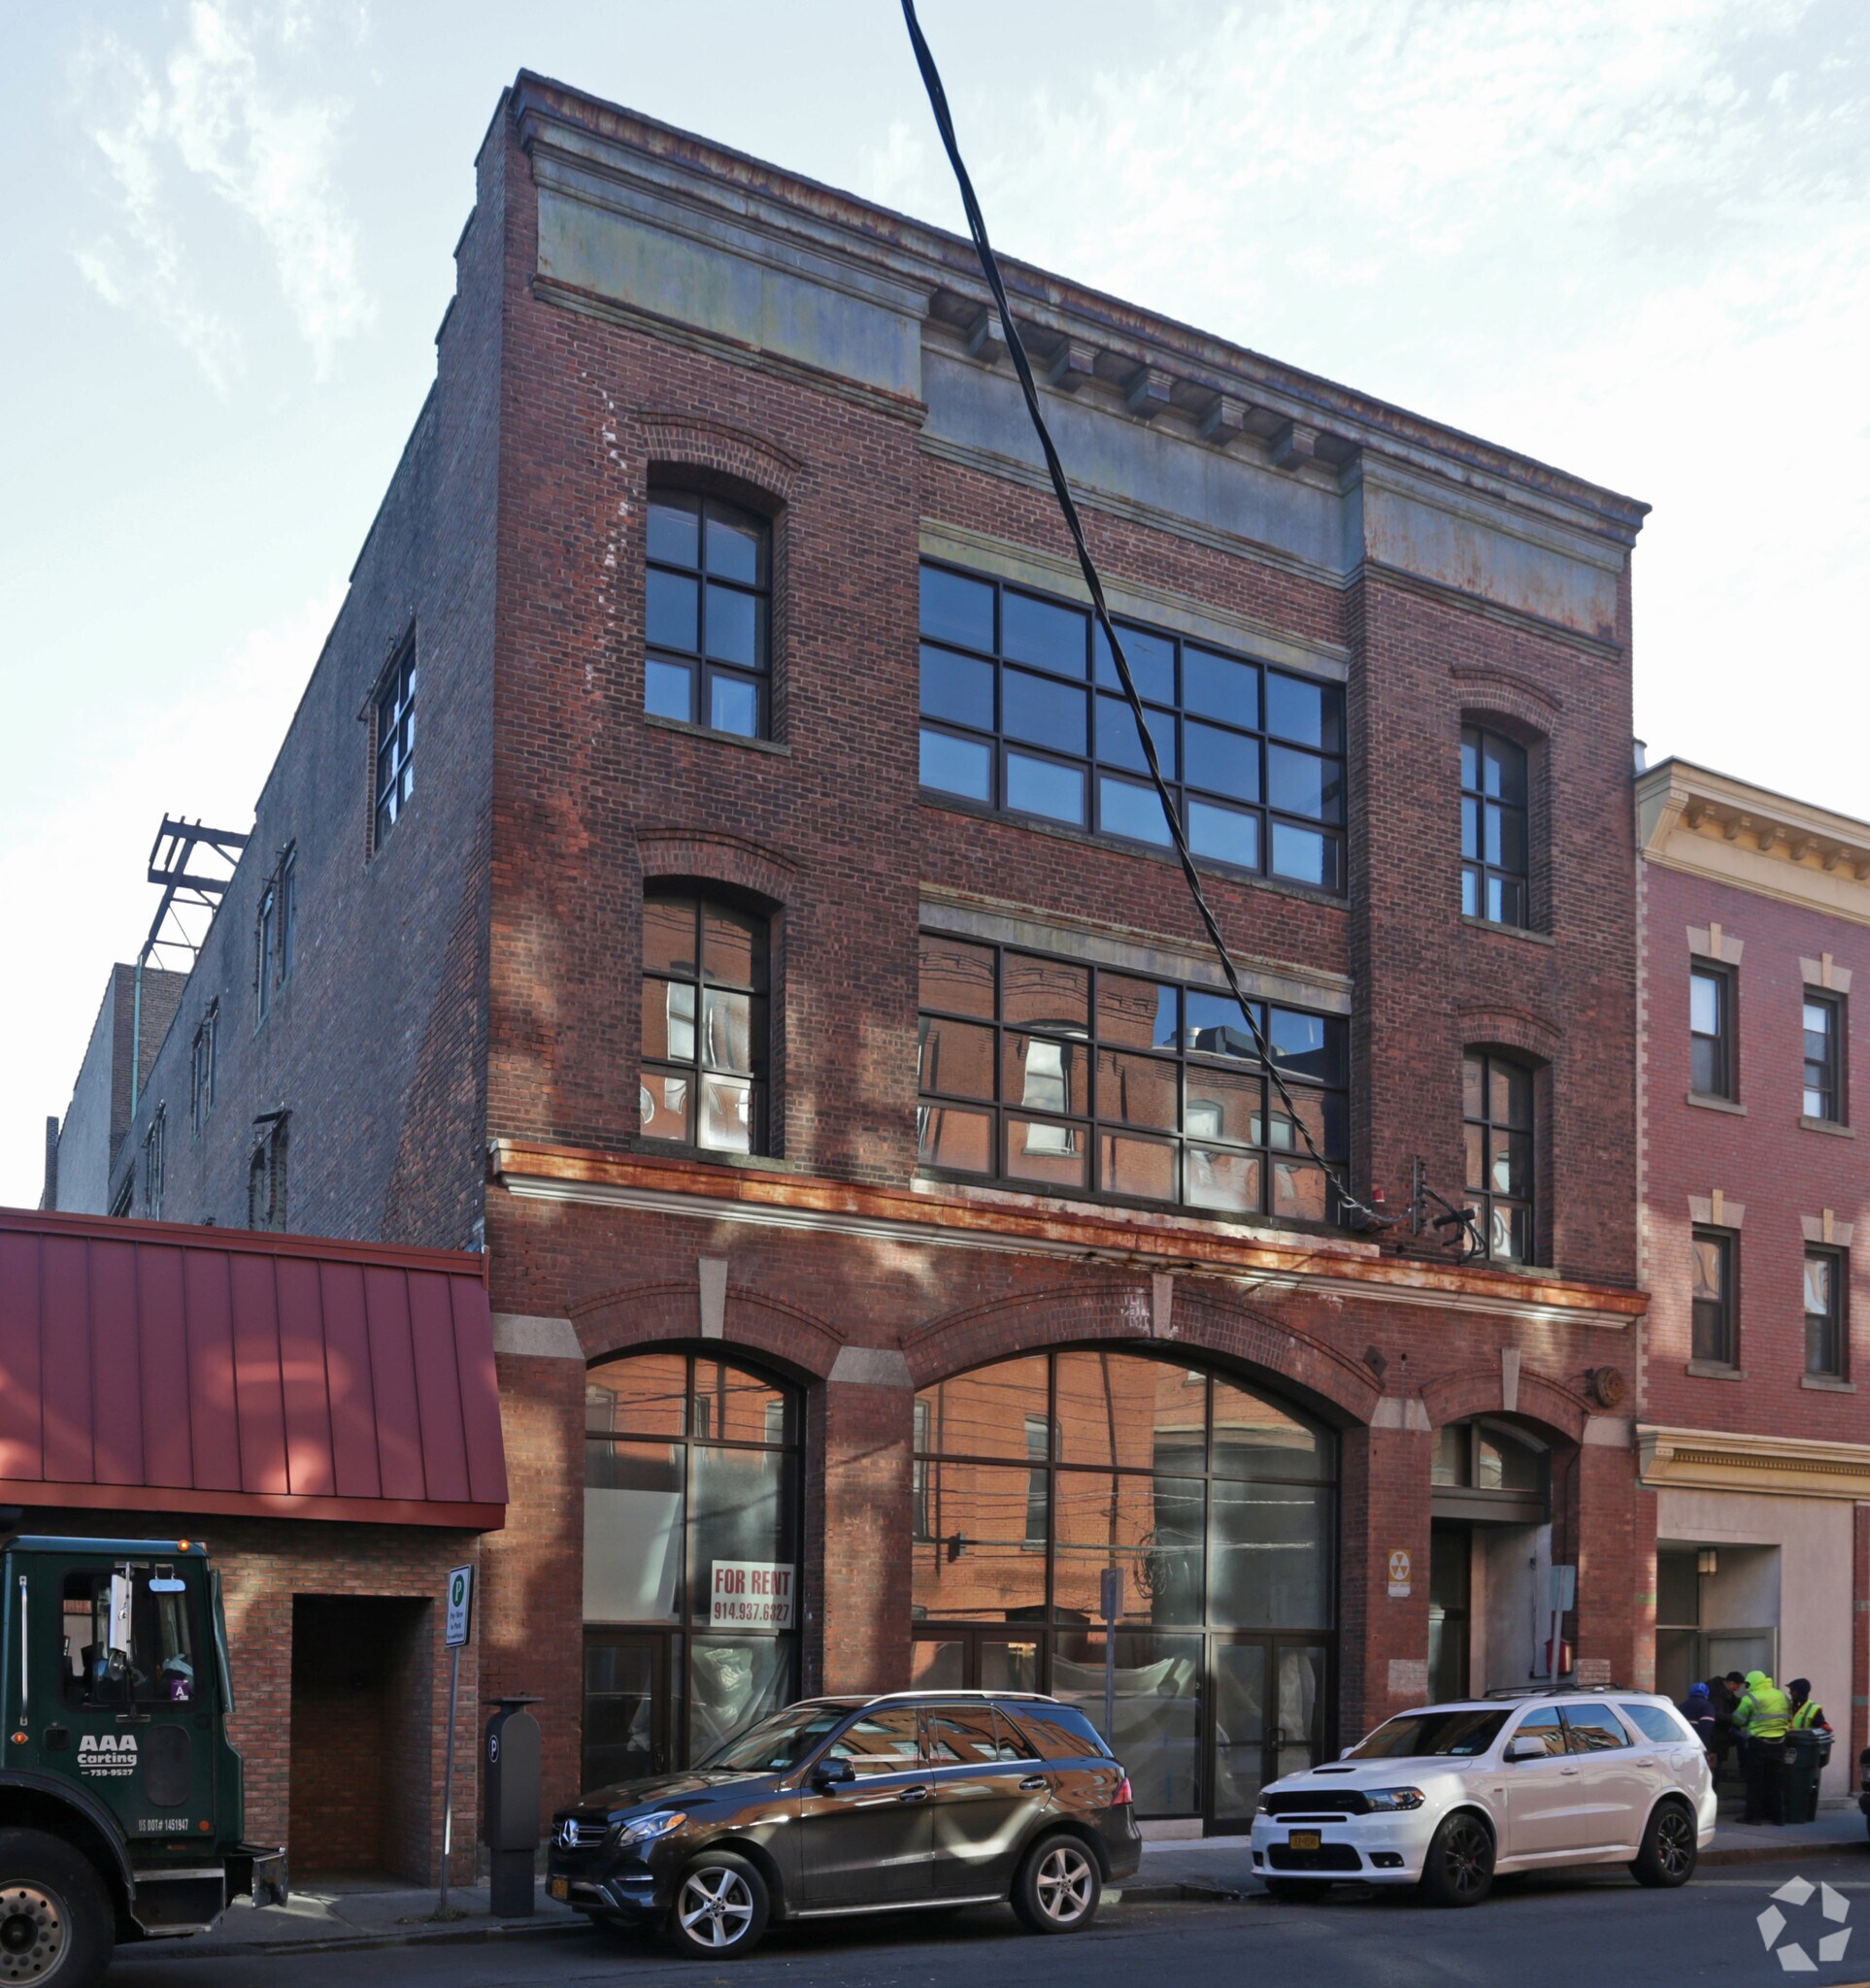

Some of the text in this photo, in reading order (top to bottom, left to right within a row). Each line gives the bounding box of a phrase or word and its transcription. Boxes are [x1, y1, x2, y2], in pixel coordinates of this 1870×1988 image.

[454, 1580, 462, 1602] P
[716, 1569, 790, 1595] FOR RENT
[714, 1602, 789, 1621] 914.937.6327
[176, 1686, 184, 1696] A
[79, 1735, 138, 1751] AAA
[491, 1739, 497, 1757] P
[77, 1752, 138, 1767] Carting
